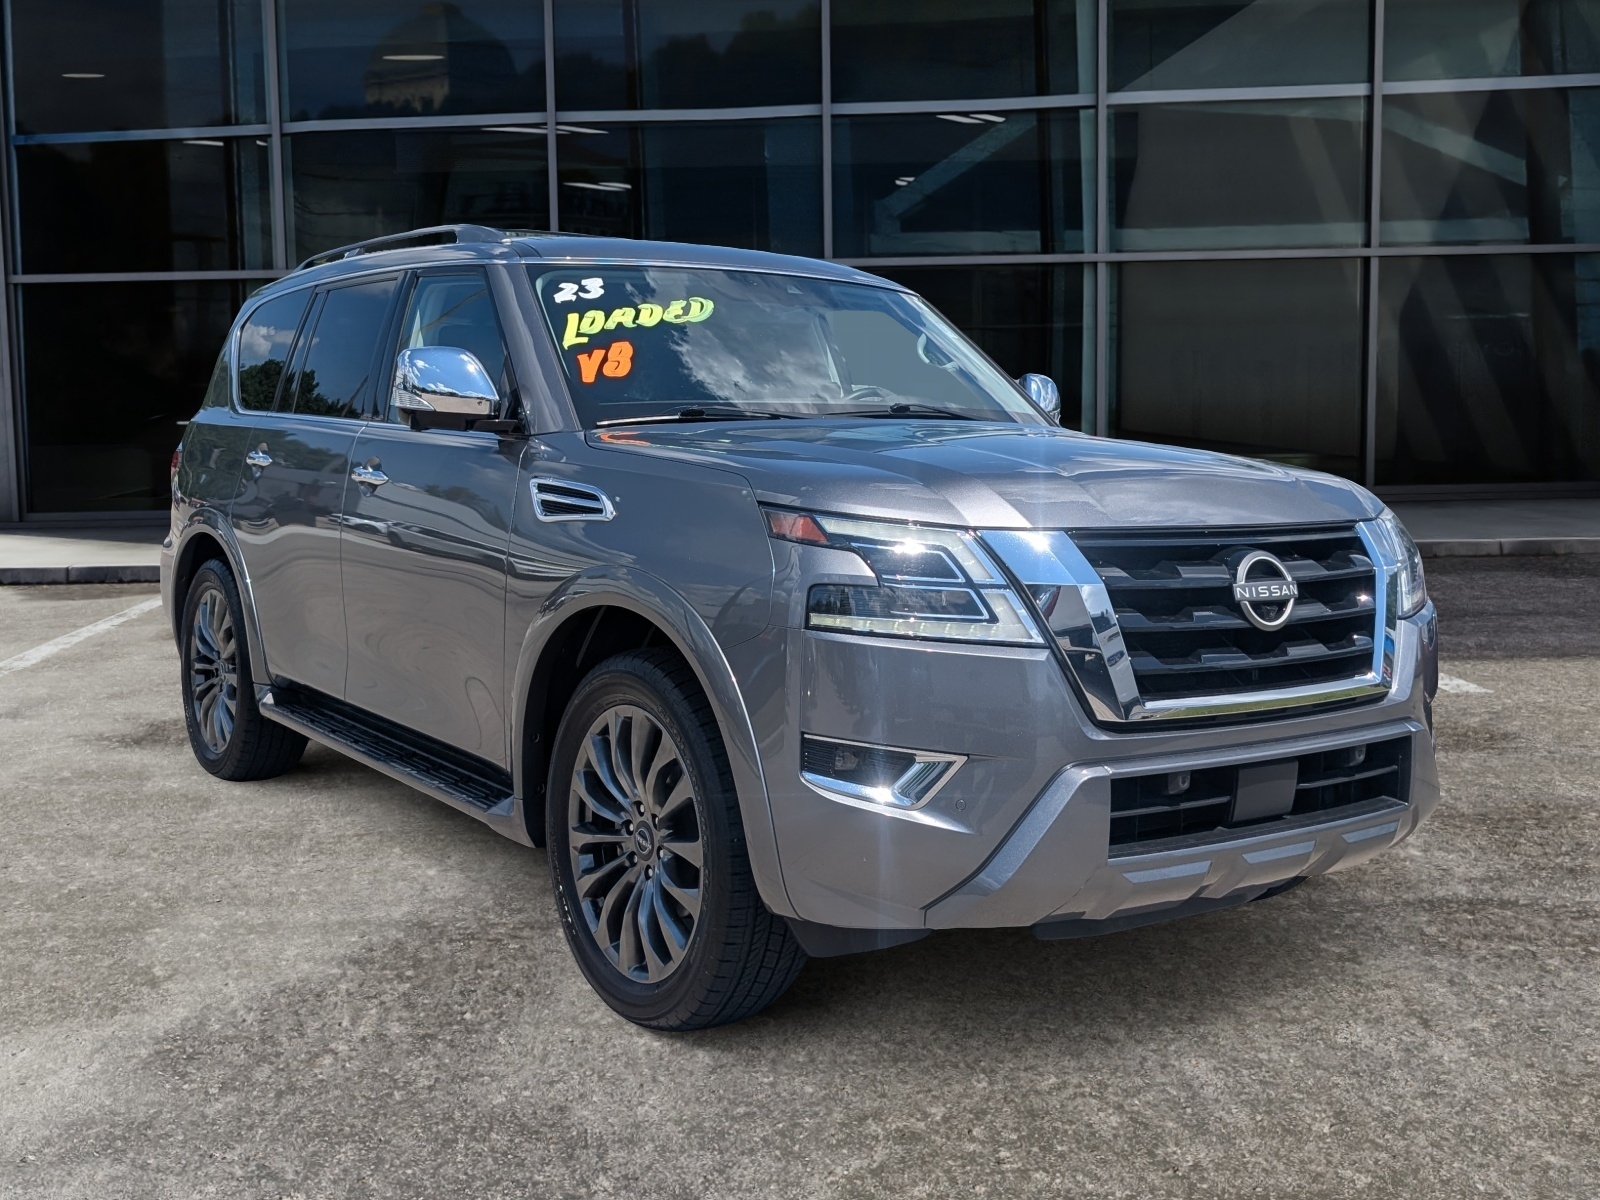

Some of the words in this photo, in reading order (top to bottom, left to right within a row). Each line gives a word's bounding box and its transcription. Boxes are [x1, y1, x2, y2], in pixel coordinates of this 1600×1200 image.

[553, 277, 605, 304] 23
[562, 296, 715, 350] LOADED
[576, 341, 634, 383] V8
[1236, 584, 1298, 599] NISSAN
